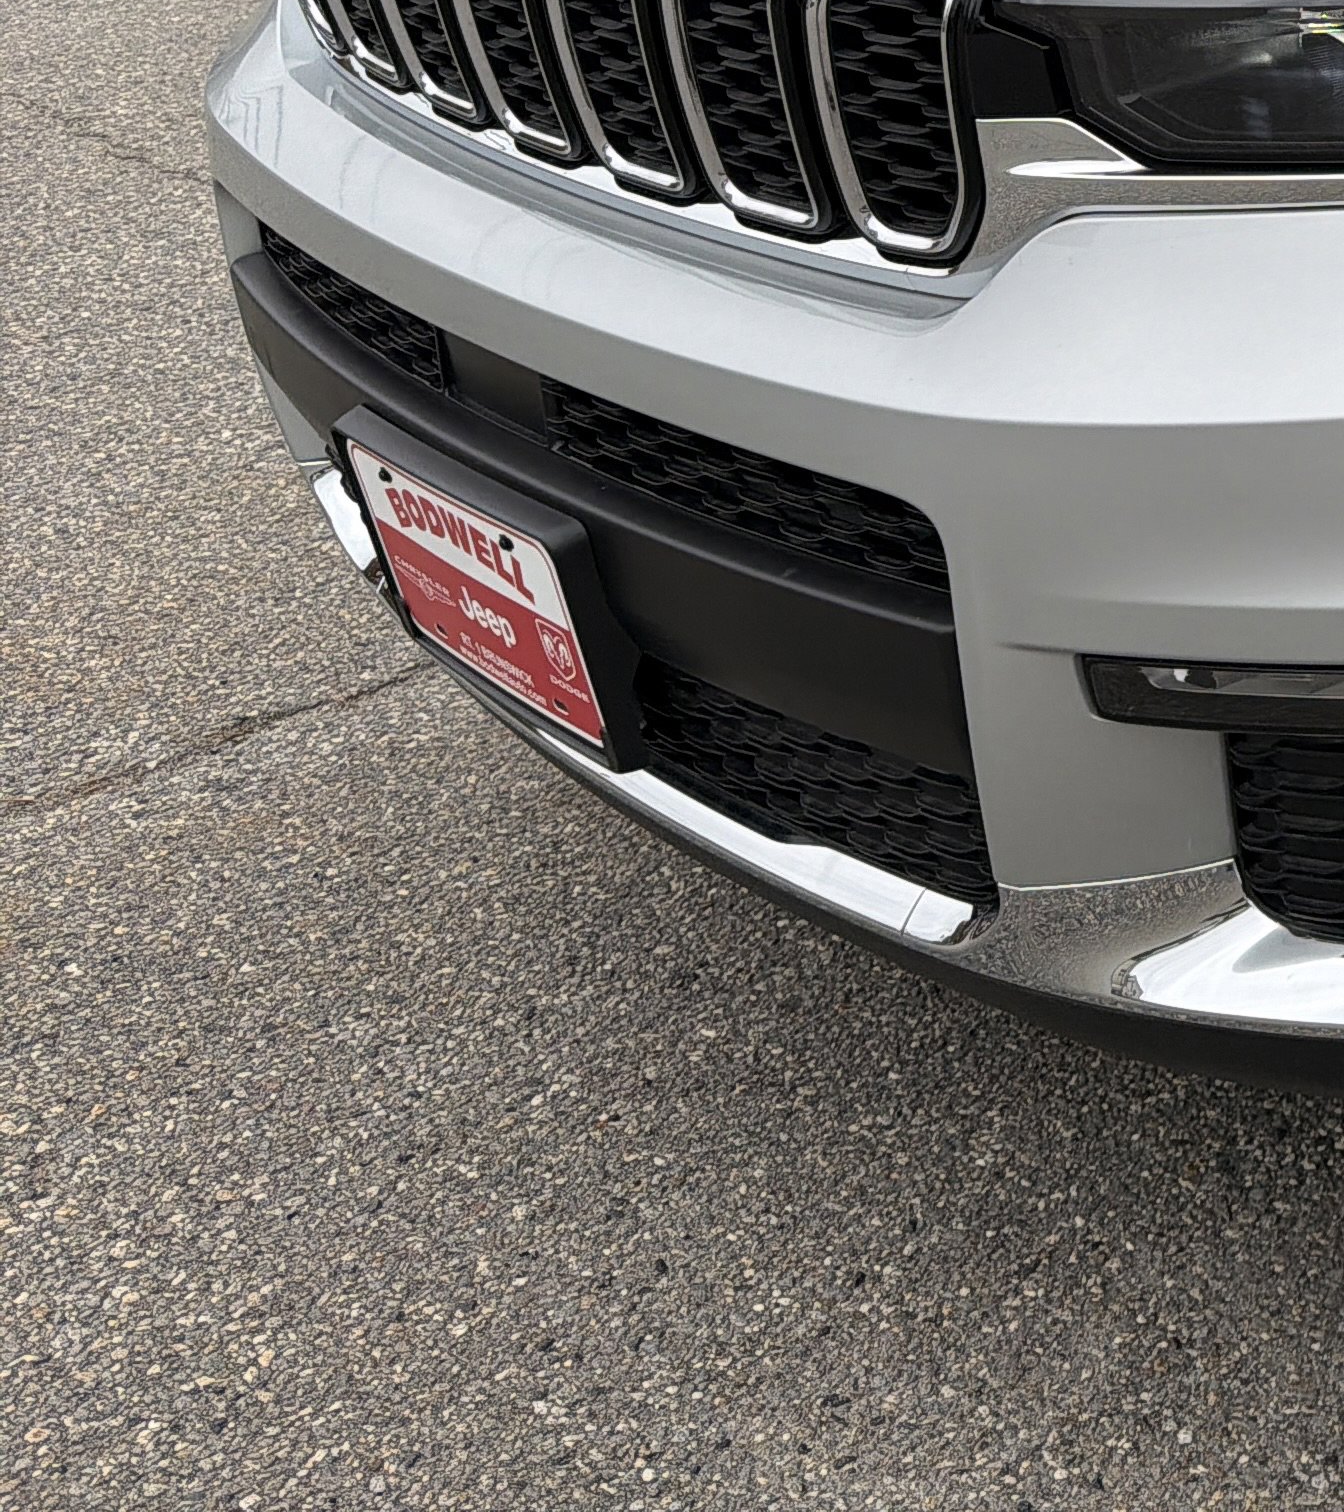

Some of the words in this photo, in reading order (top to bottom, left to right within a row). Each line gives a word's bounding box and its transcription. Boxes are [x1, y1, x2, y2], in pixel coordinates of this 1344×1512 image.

[385, 488, 536, 606] BODWELL
[394, 555, 450, 598] CHRYSLER
[458, 586, 517, 649] Jeep
[549, 674, 590, 704] DODGE
